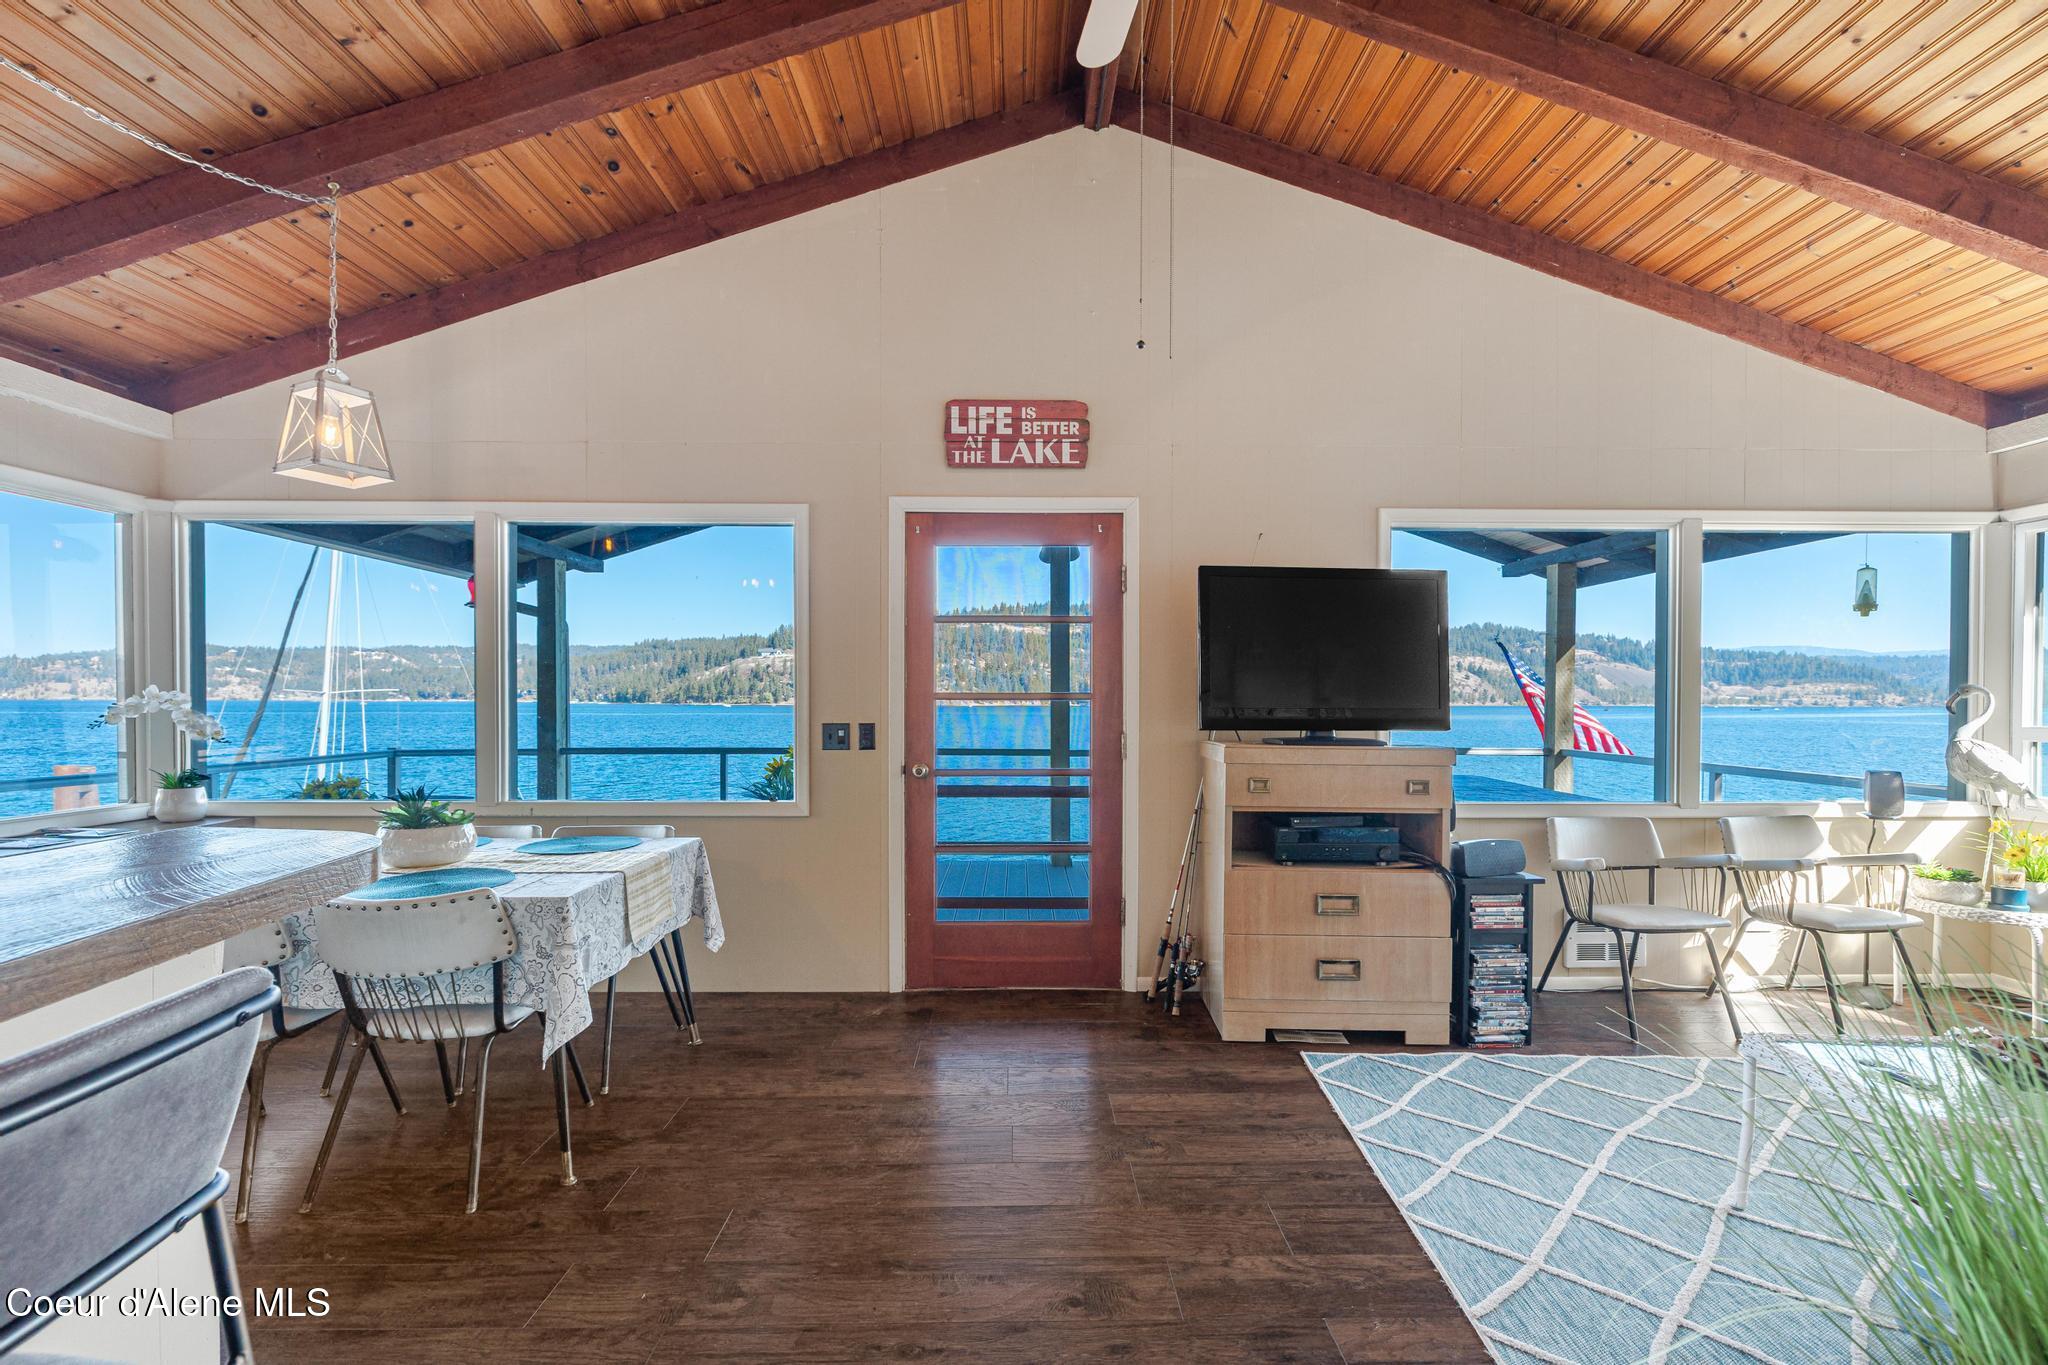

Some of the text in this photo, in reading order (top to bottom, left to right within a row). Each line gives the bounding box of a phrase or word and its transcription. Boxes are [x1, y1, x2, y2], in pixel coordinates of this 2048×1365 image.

[951, 406, 1037, 434] LIFE IS
[1021, 421, 1080, 435] BETTER
[951, 438, 1080, 464] THE LAKE
[964, 435, 986, 449] AT
